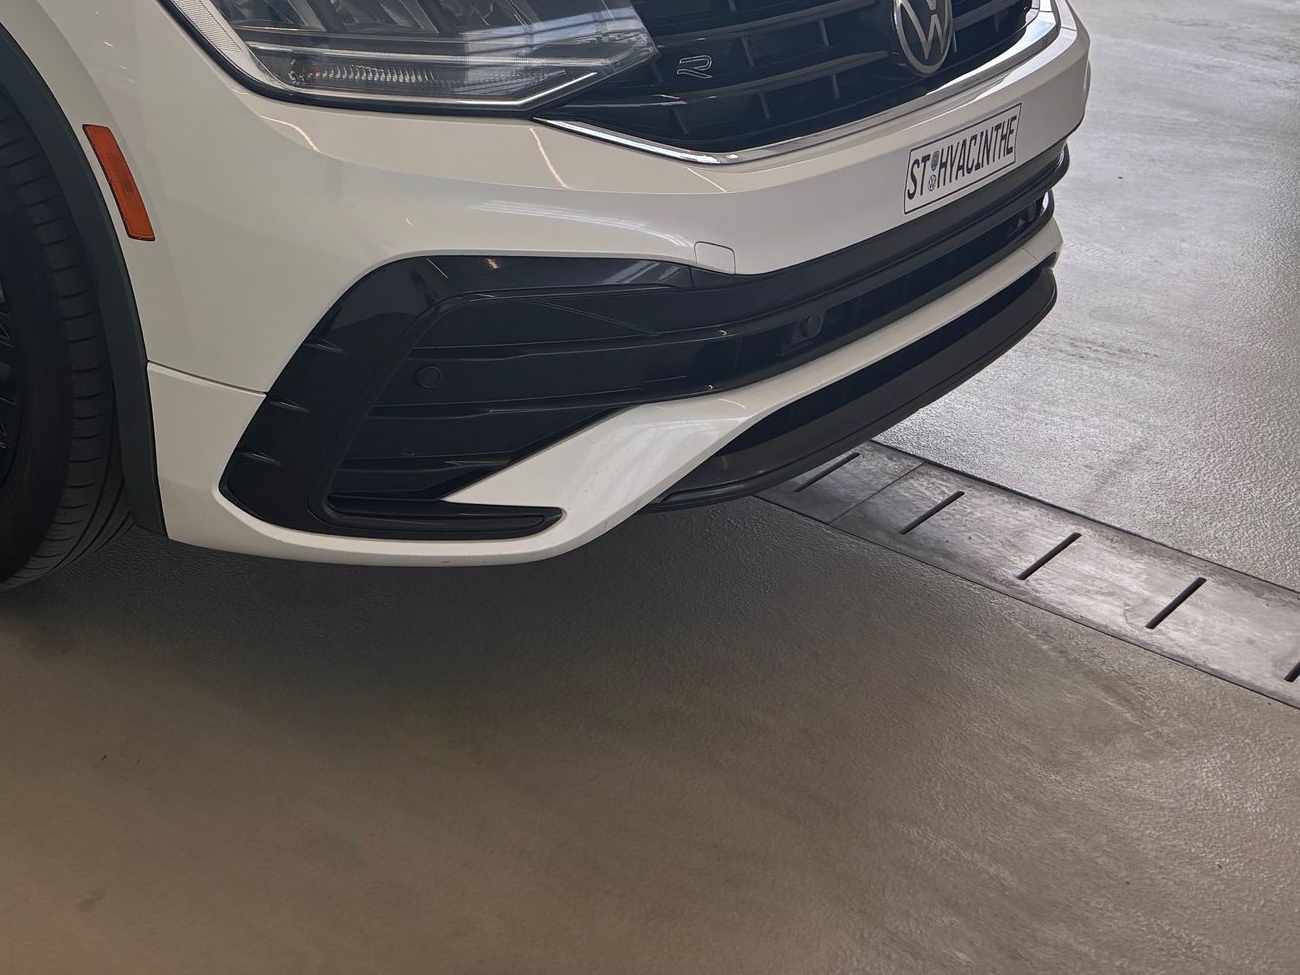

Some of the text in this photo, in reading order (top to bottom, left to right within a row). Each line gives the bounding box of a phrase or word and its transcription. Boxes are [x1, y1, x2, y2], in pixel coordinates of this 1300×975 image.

[676, 53, 713, 79] R
[907, 114, 1017, 200] ST HYACINTHE
